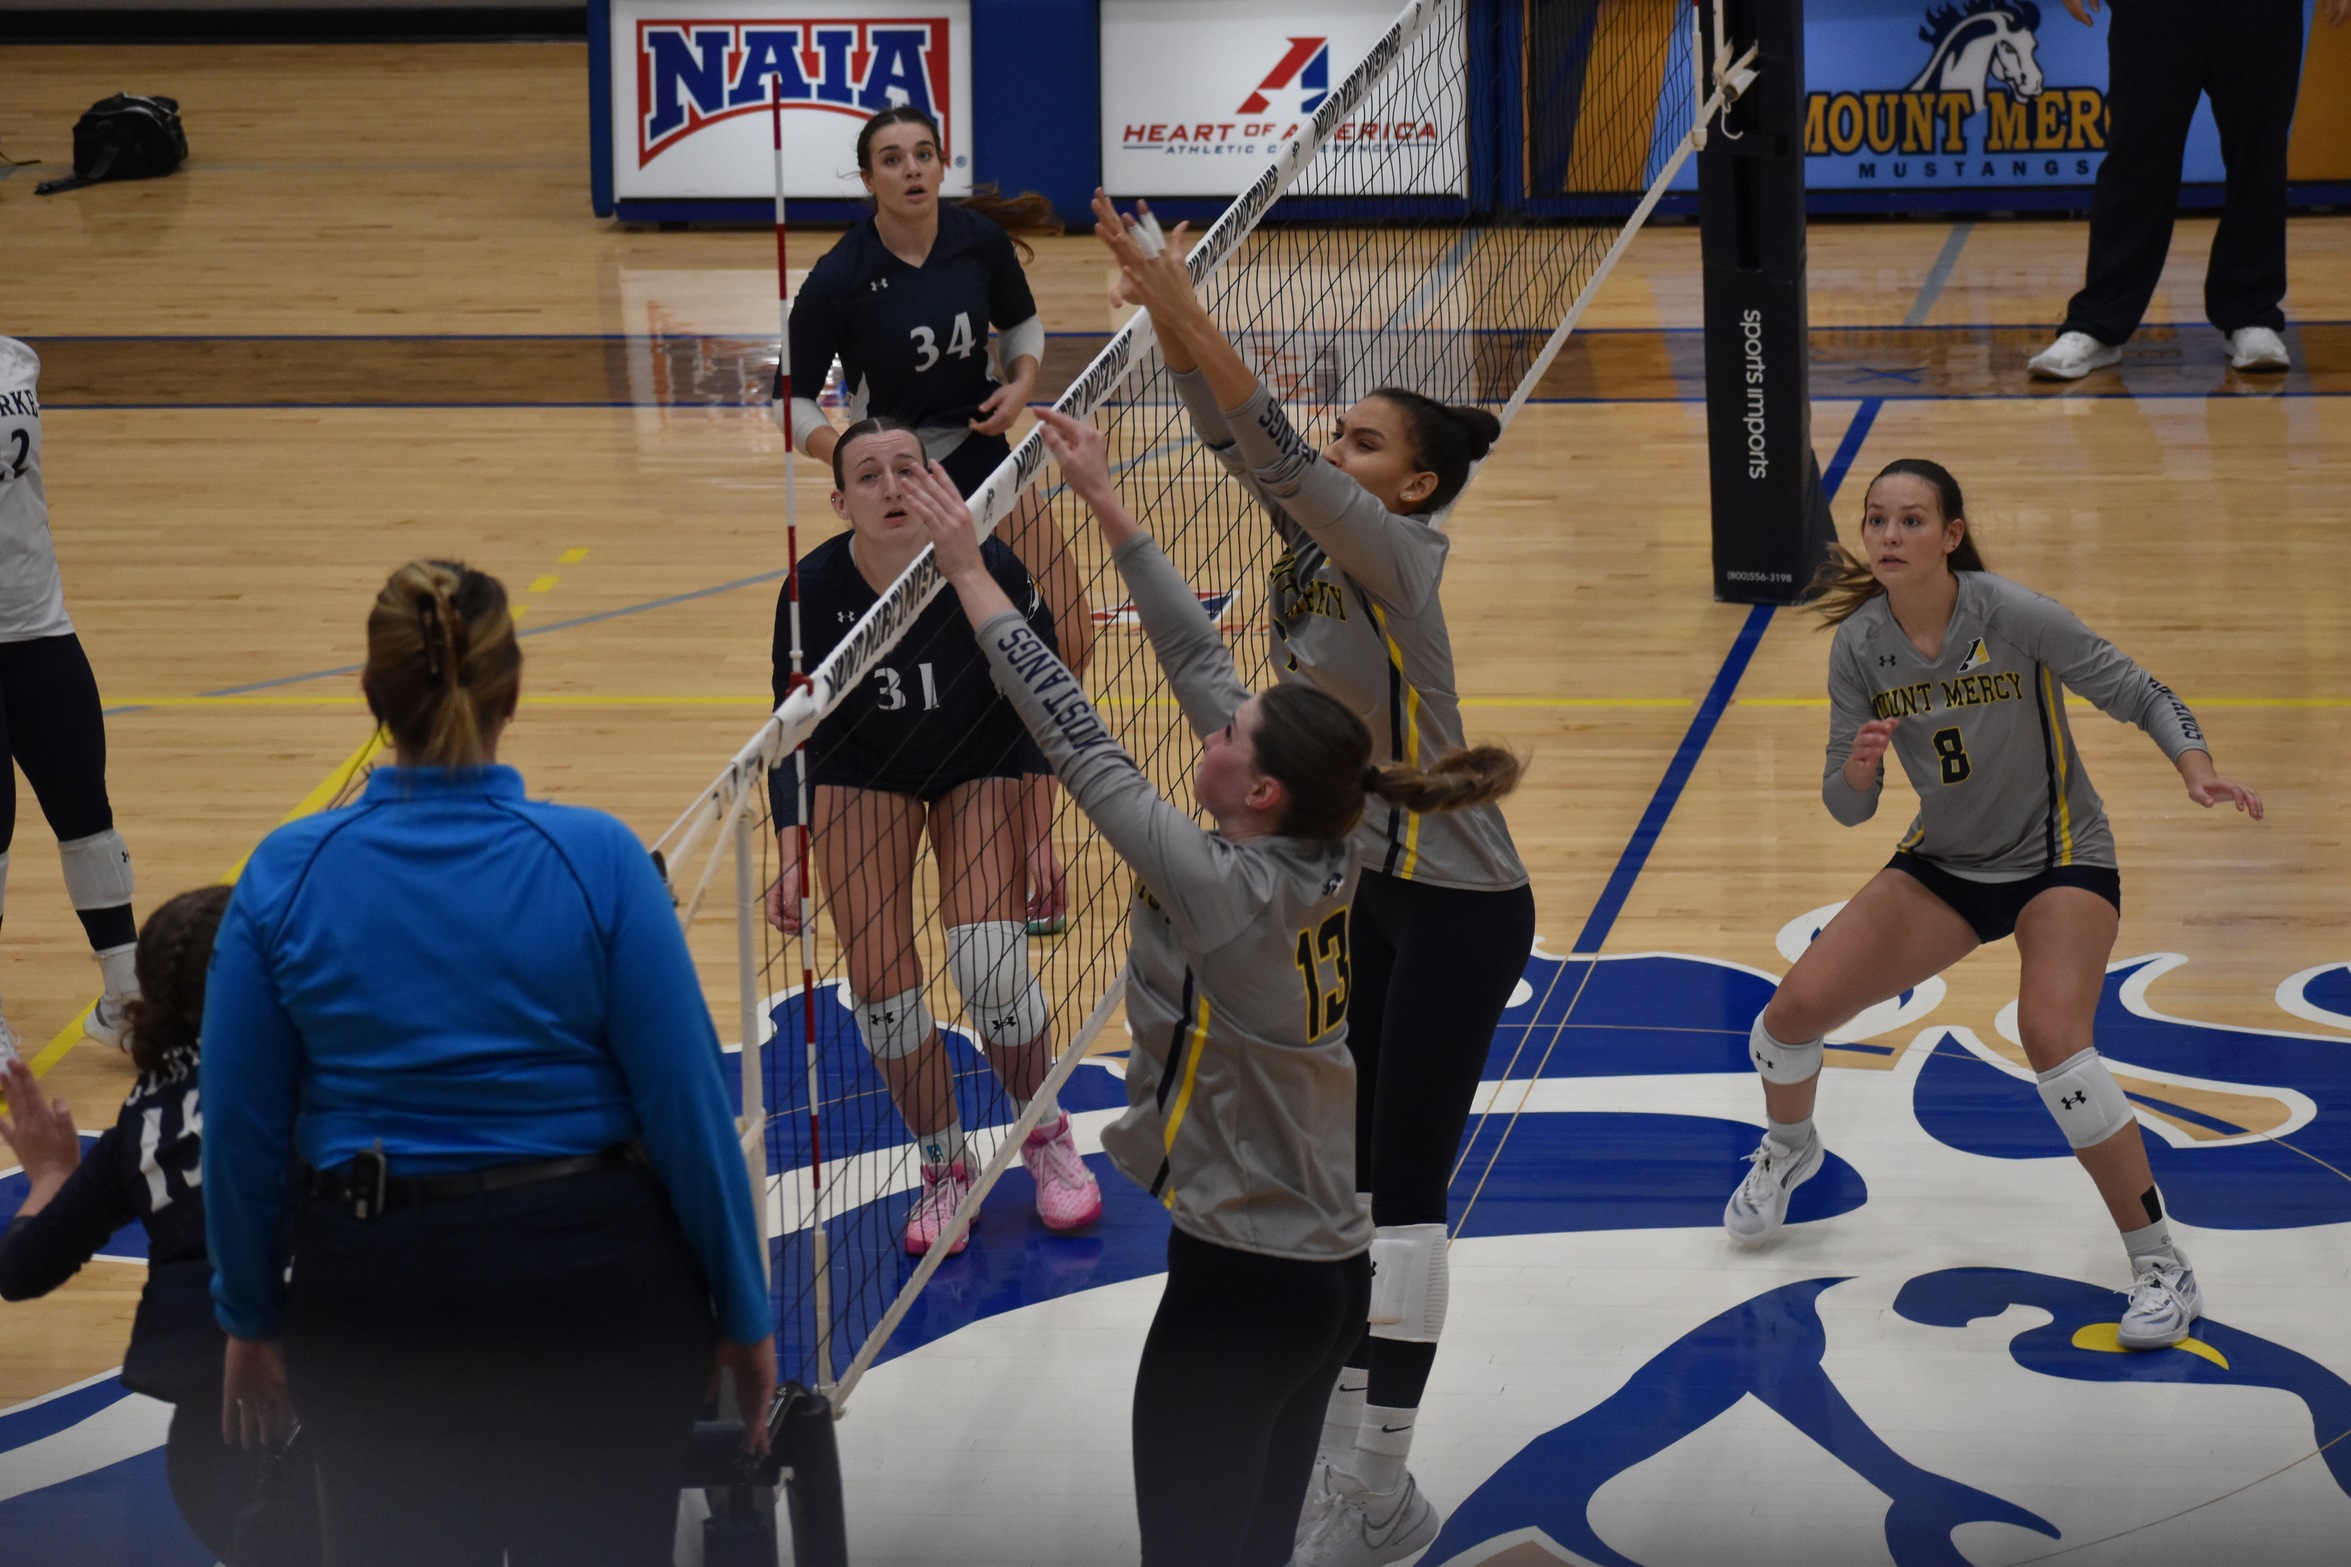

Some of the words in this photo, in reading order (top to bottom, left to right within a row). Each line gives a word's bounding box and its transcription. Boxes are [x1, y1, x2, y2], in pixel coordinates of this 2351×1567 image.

[645, 28, 940, 143] NAIA
[1122, 123, 1236, 143] HEART
[1243, 123, 1277, 137] OF
[1165, 145, 1256, 155] ATHLETIC
[1986, 89, 2112, 151] MER
[1858, 161, 2090, 179] MUSTANGS
[910, 311, 977, 373] 34
[1740, 309, 1766, 384] sports
[1743, 388, 1769, 480] imports
[873, 662, 941, 711] 31
[1939, 671, 2023, 708] MERCY
[1932, 726, 1972, 785] 8
[1295, 904, 1350, 1043] 13
